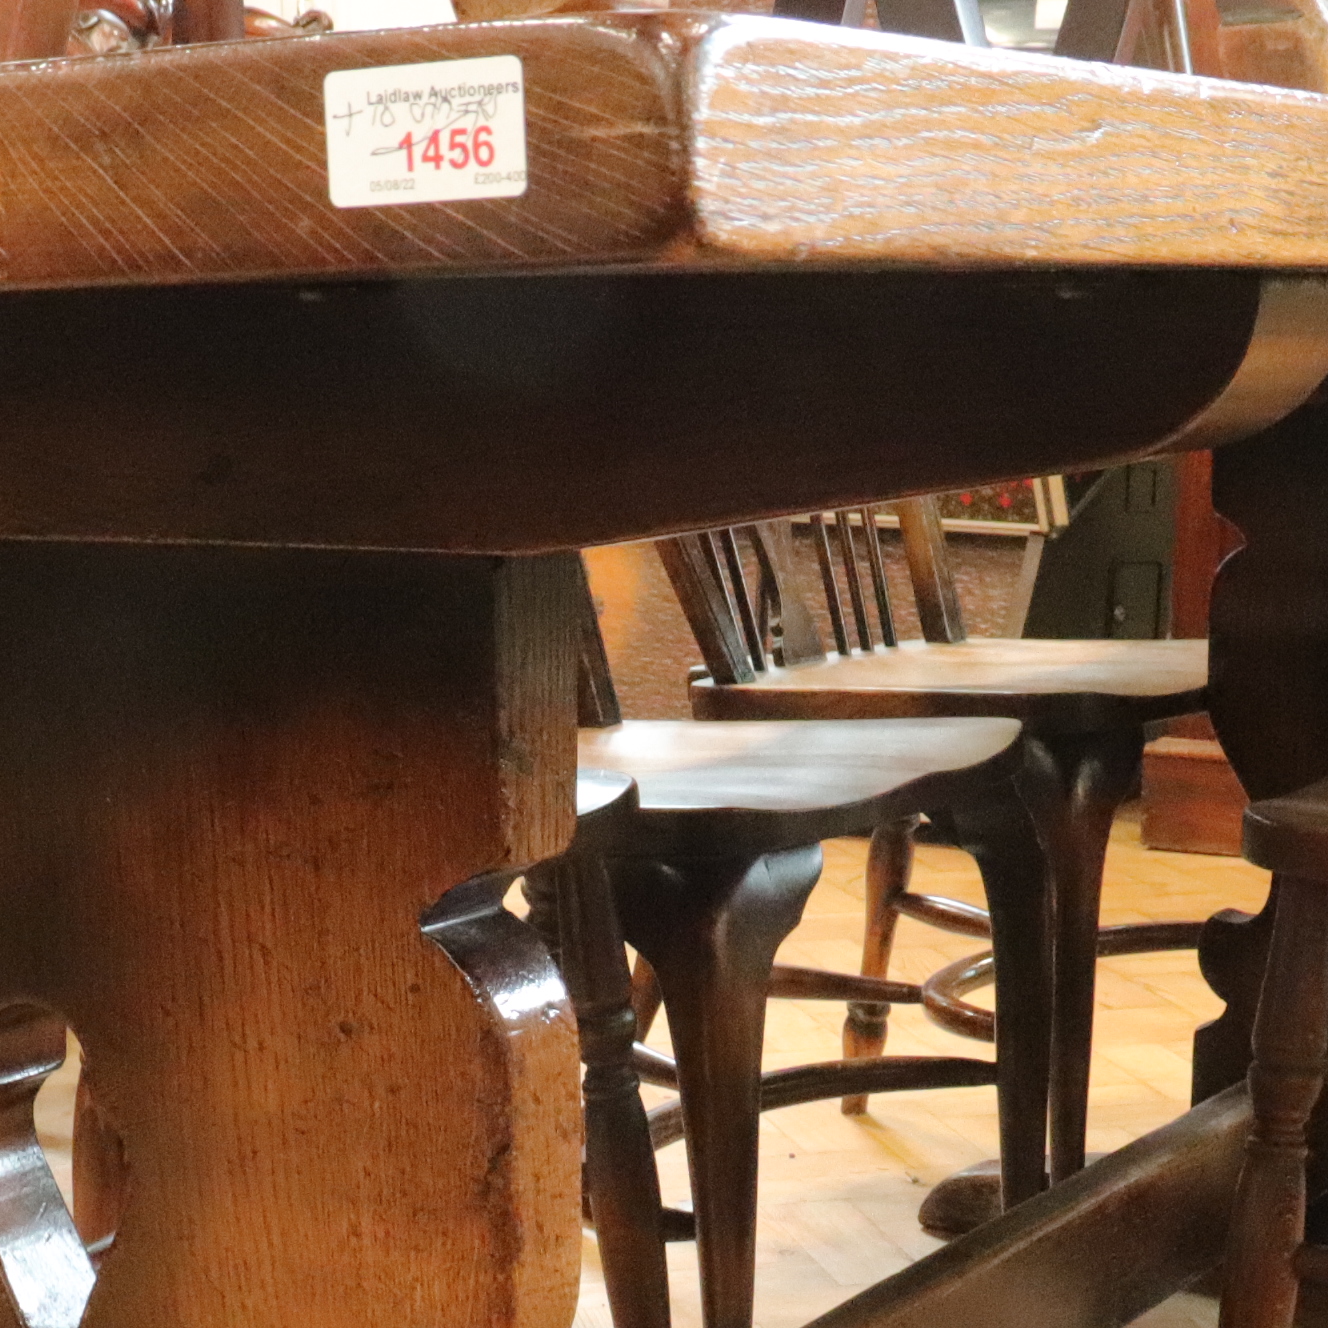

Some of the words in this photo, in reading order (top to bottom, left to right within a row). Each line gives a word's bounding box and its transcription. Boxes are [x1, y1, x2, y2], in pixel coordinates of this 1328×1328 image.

[367, 87, 423, 105] Laidlaw
[428, 81, 520, 101] Auctioneers
[399, 125, 495, 173] 1456
[370, 178, 416, 193] 05/08/22
[474, 170, 526, 185] £200-400
